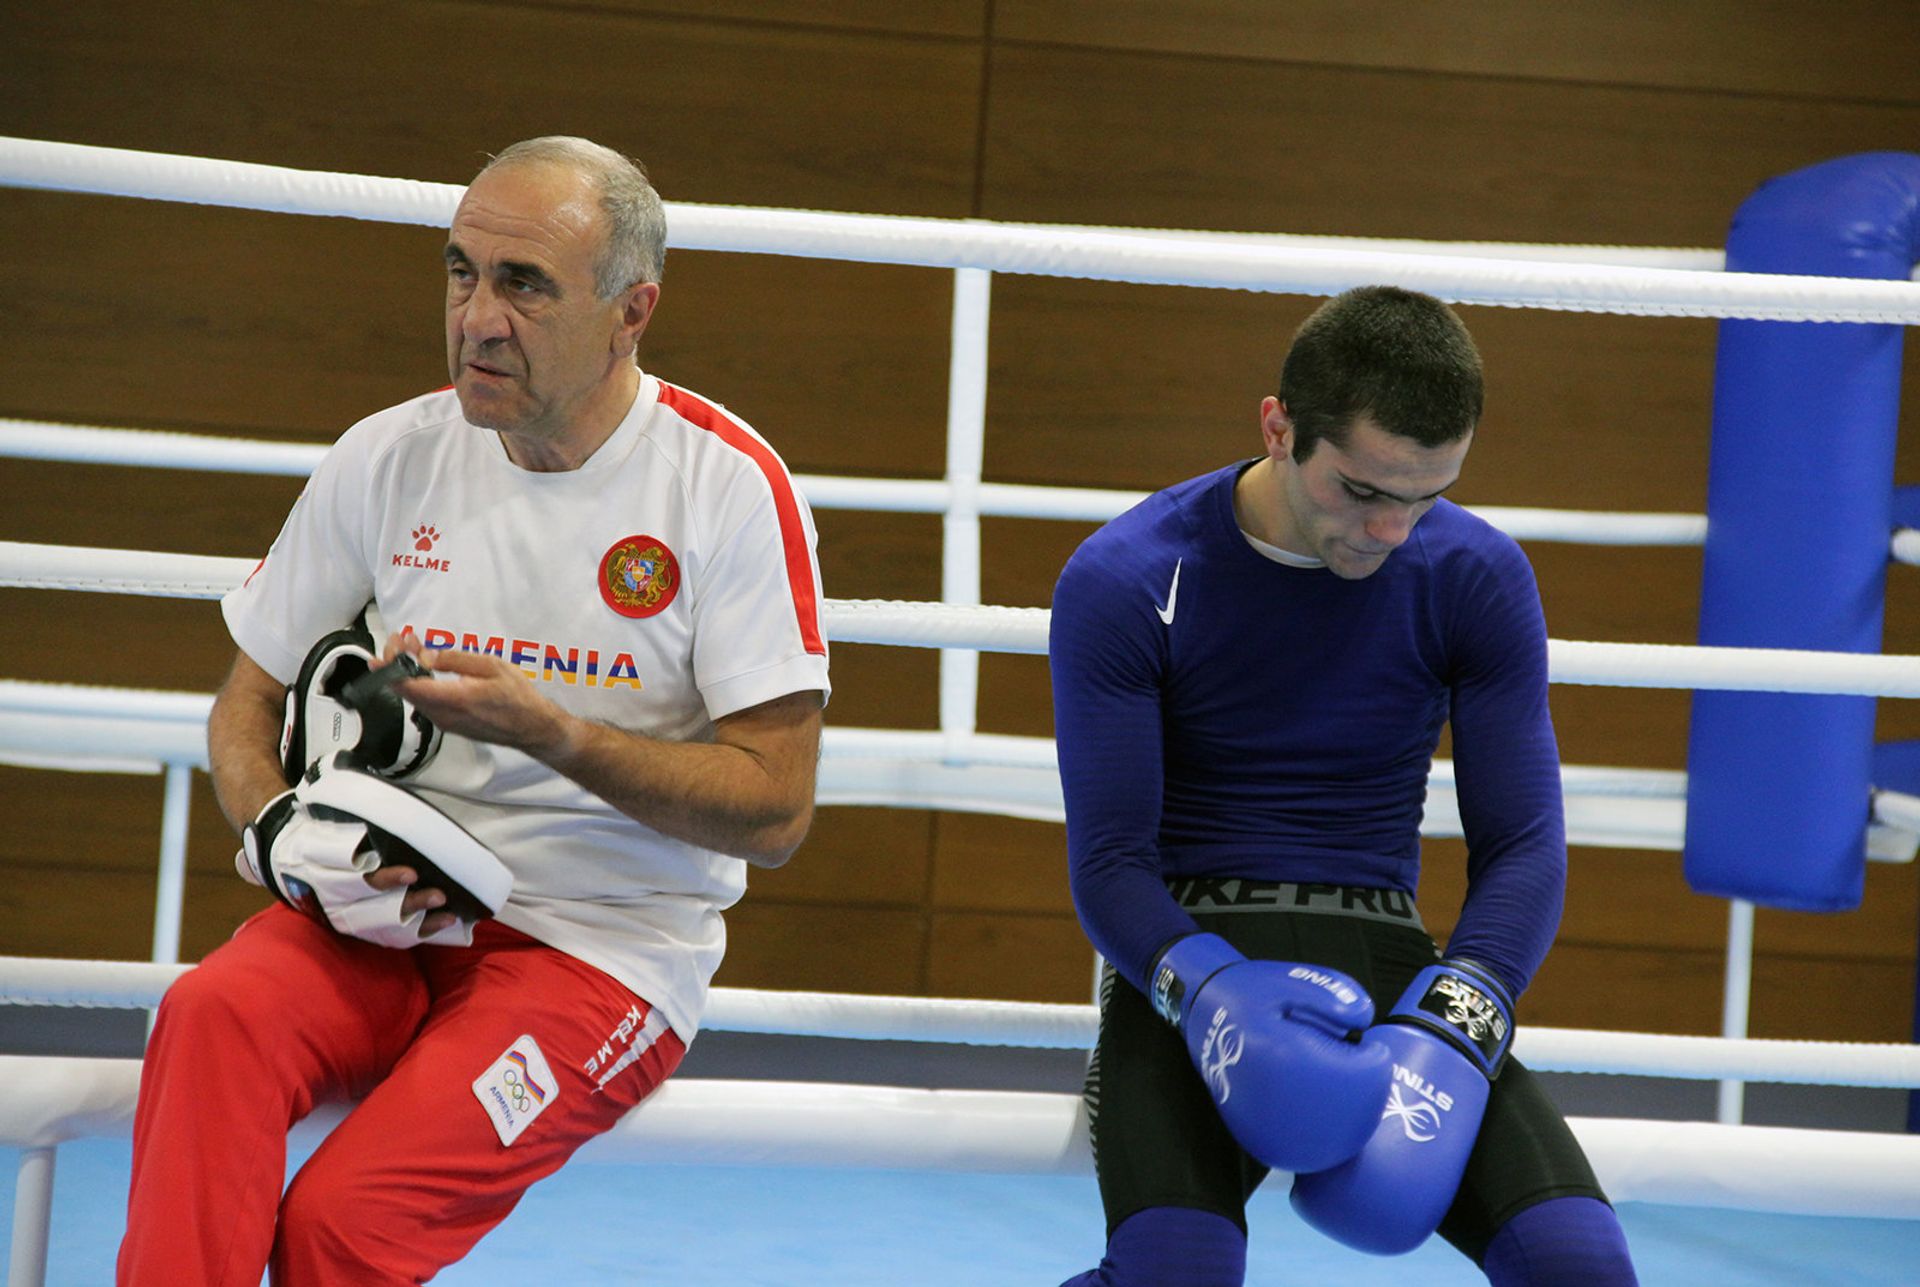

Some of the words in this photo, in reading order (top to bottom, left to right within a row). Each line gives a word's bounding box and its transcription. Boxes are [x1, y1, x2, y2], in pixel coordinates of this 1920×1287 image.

[392, 554, 450, 572] KELME
[1163, 879, 1283, 907] IKE
[1288, 967, 1359, 1005] STING
[584, 1004, 641, 1076] KELME
[1201, 1006, 1228, 1084] STI
[489, 1086, 515, 1128] ARMENIA
[1392, 1064, 1454, 1112] STIN
